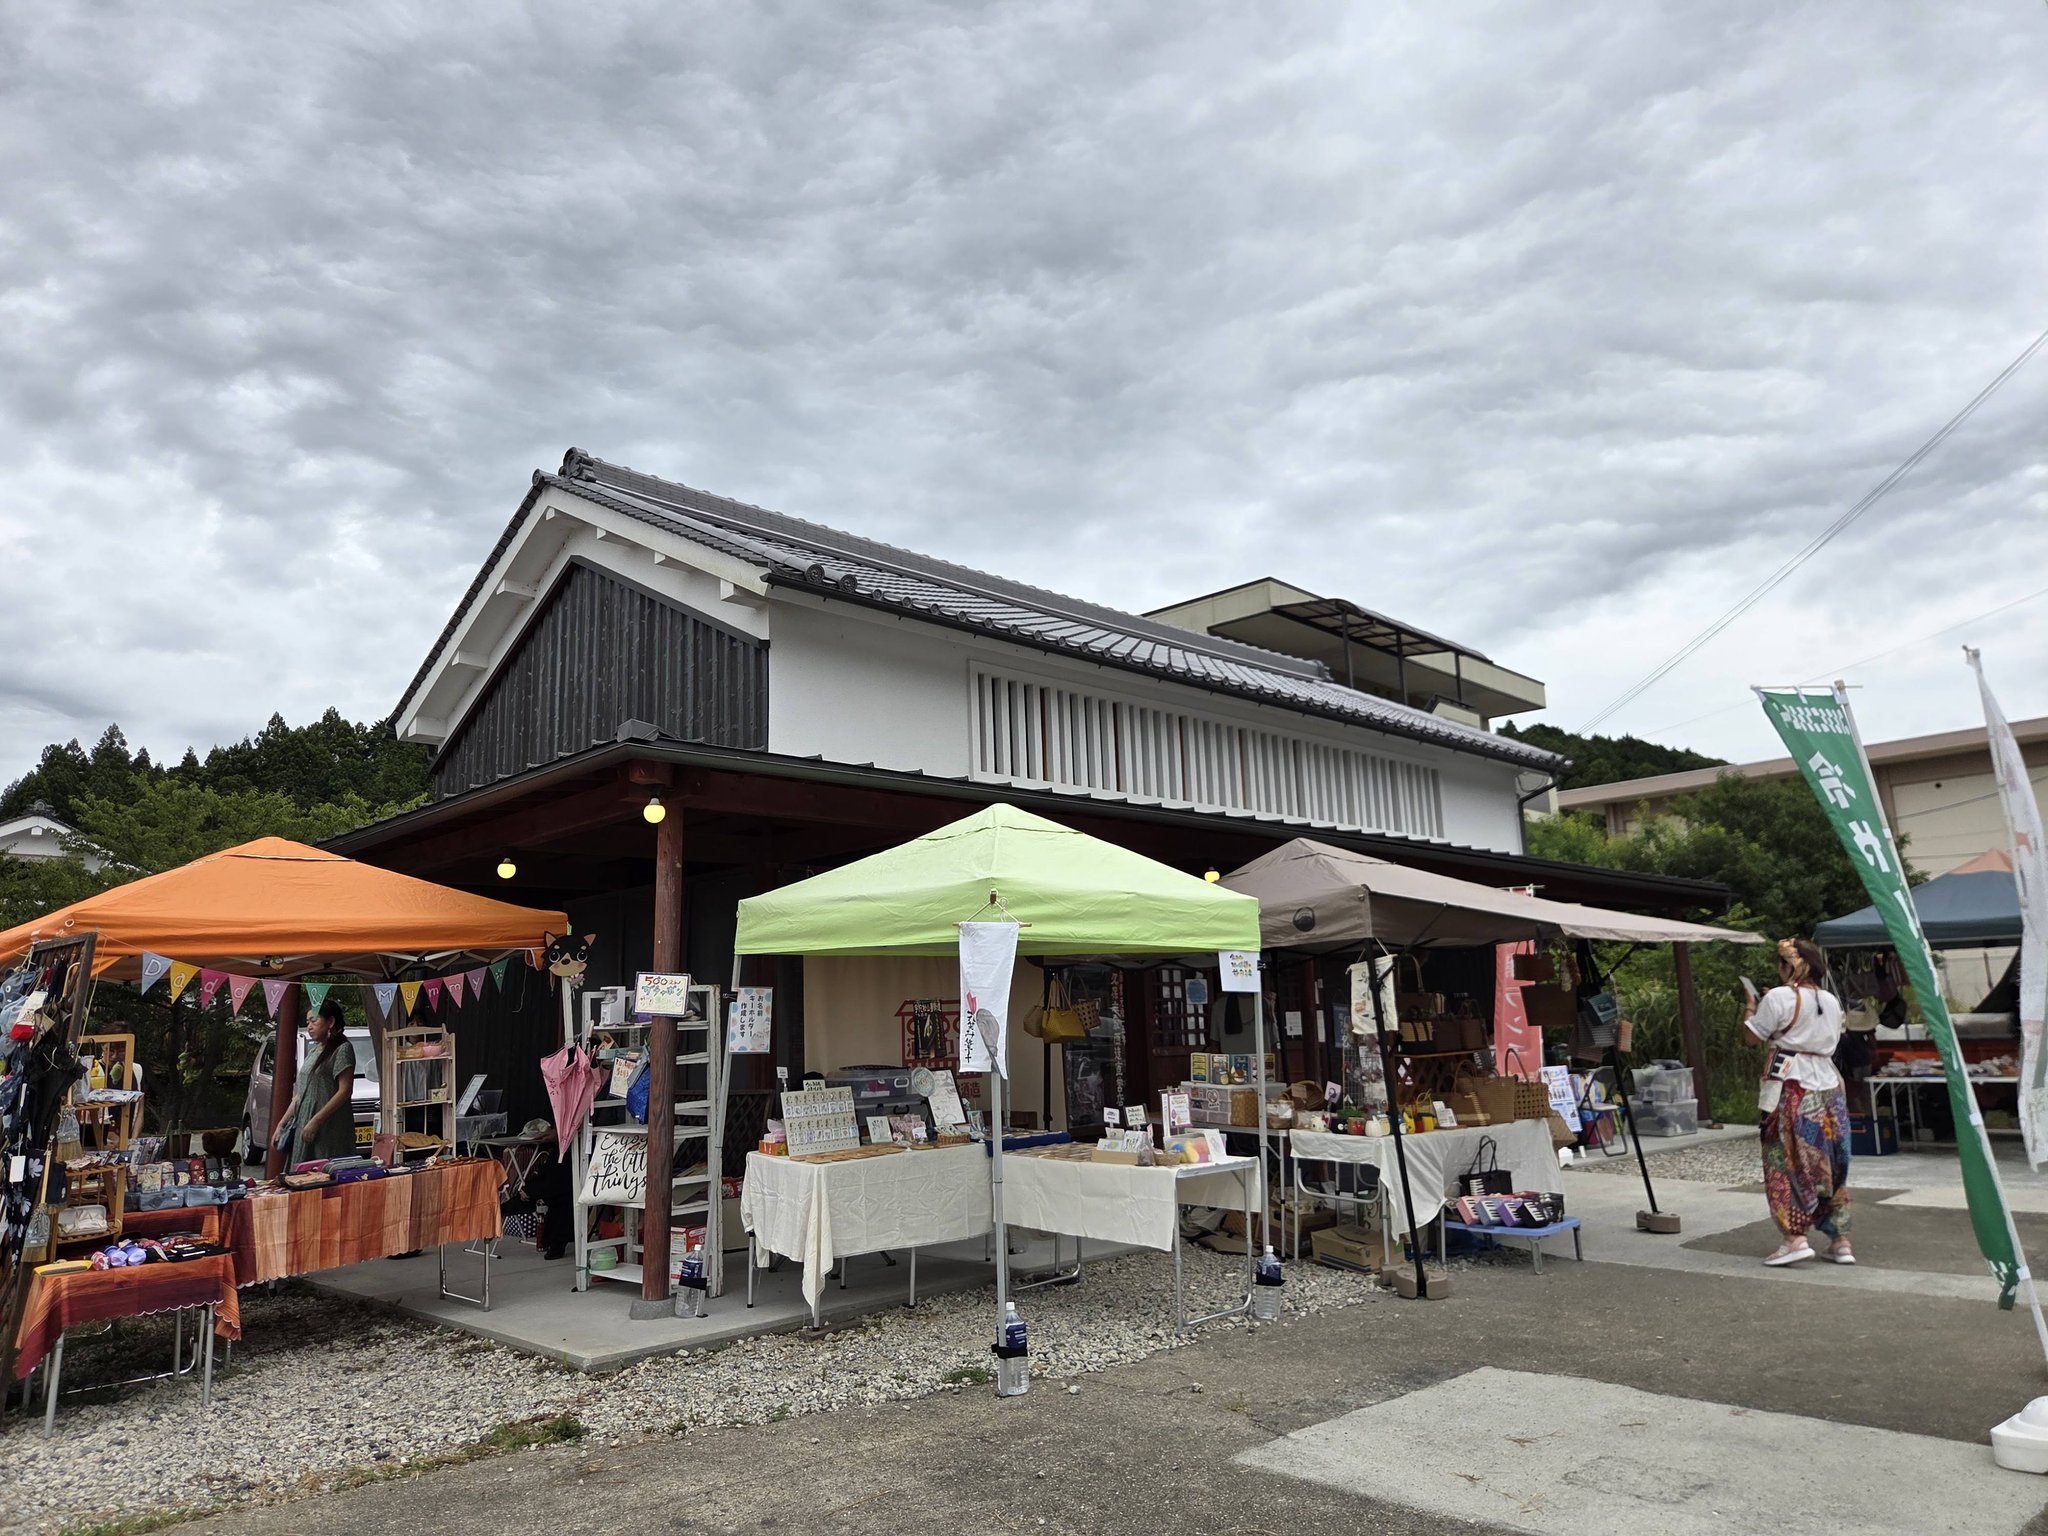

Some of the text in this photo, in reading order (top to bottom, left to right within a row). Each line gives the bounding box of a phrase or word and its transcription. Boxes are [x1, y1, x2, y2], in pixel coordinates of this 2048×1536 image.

[145, 958, 480, 1007] Daddy & Mummy
[740, 1002, 748, 1038] 作成します
[600, 1133, 648, 1153] Enjoy
[602, 1148, 648, 1173] the litt
[589, 1164, 647, 1200] things
